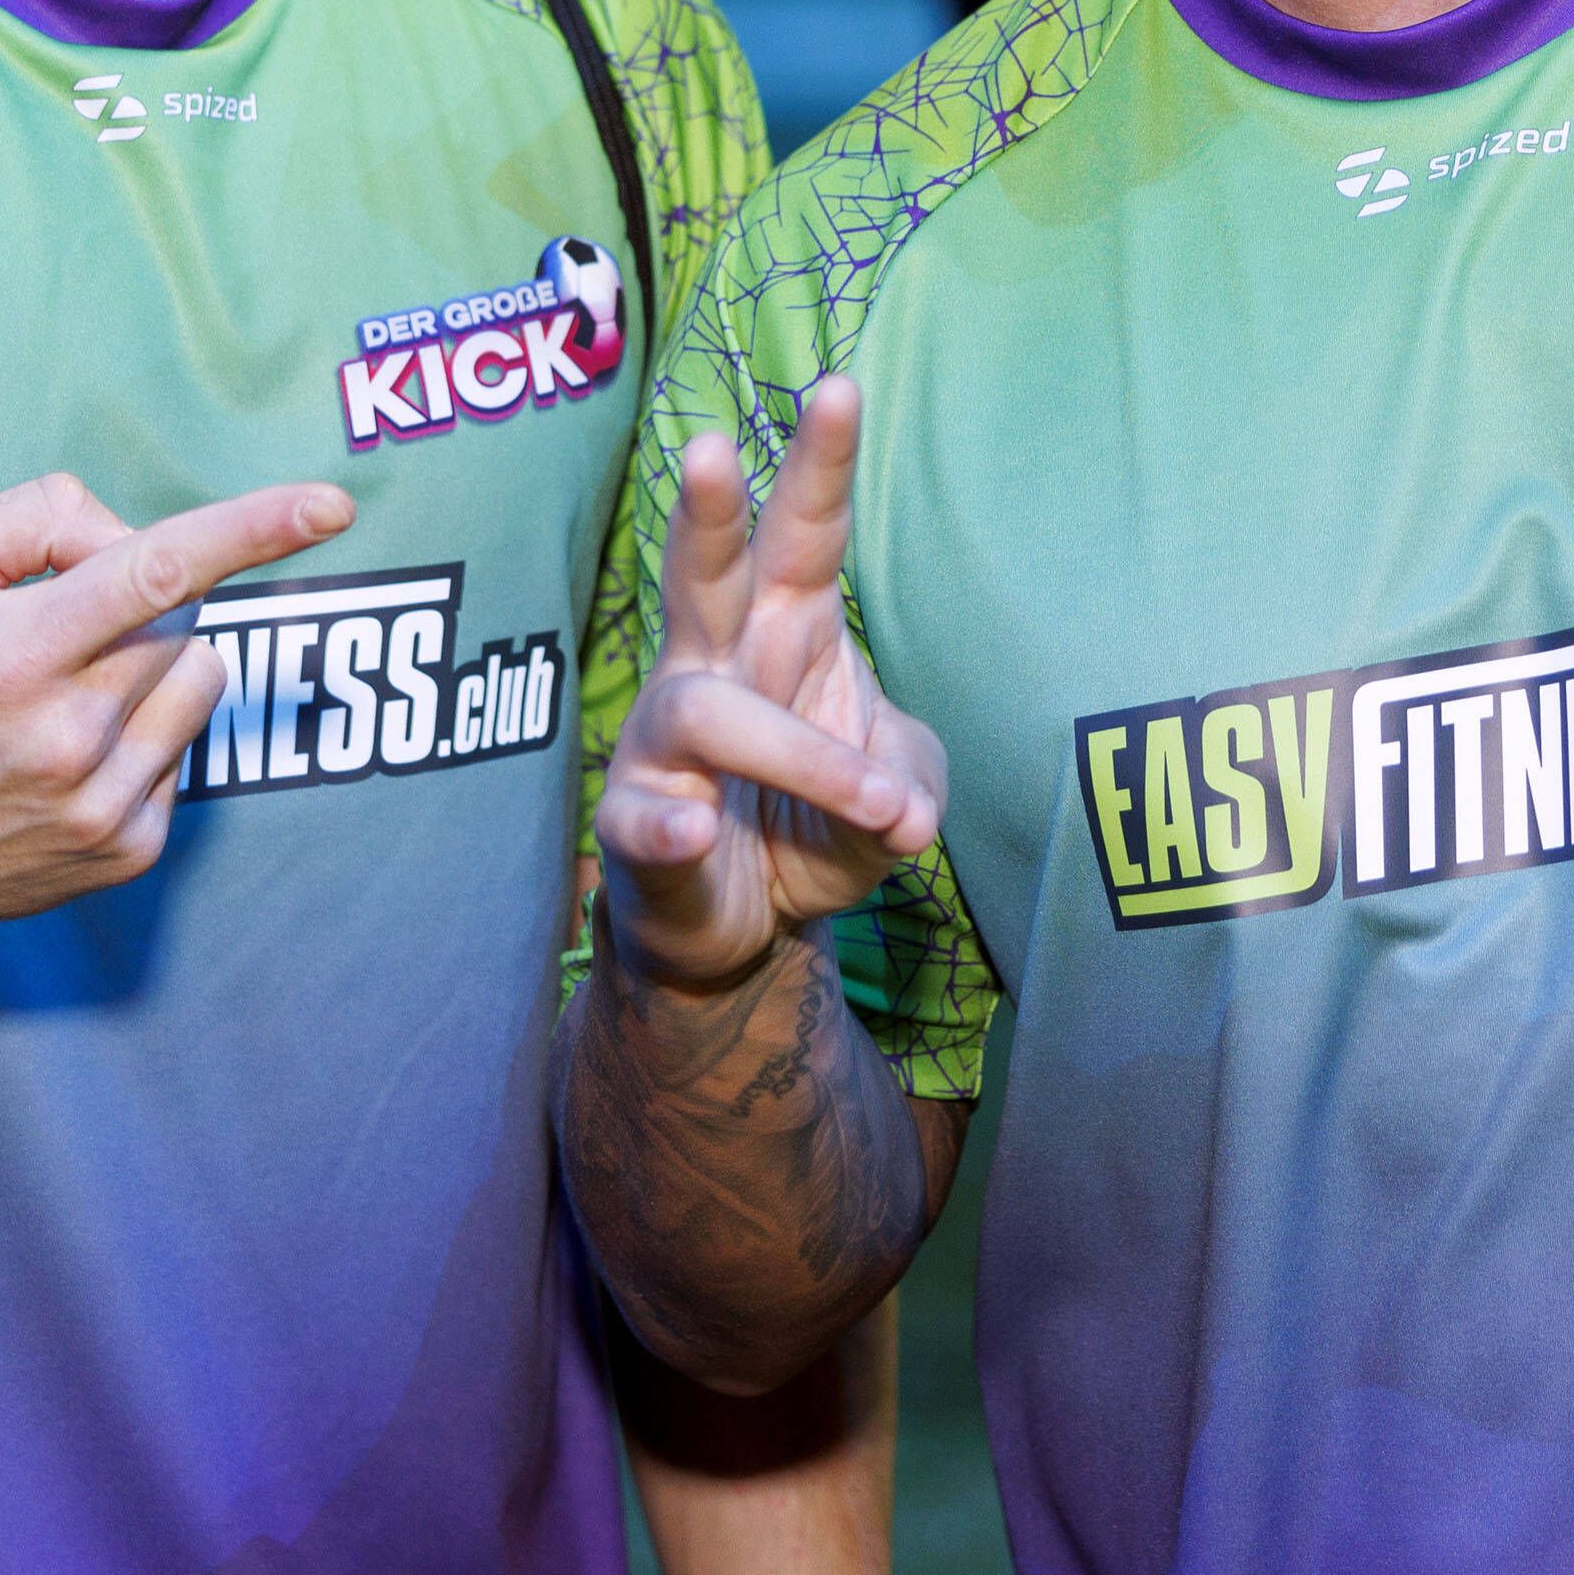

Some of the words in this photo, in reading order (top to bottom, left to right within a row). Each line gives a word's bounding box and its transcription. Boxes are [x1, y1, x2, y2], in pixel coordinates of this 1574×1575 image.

[163, 85, 258, 123] spized
[1427, 119, 1572, 181] spized
[362, 309, 439, 349] DER
[342, 311, 590, 440] KICK
